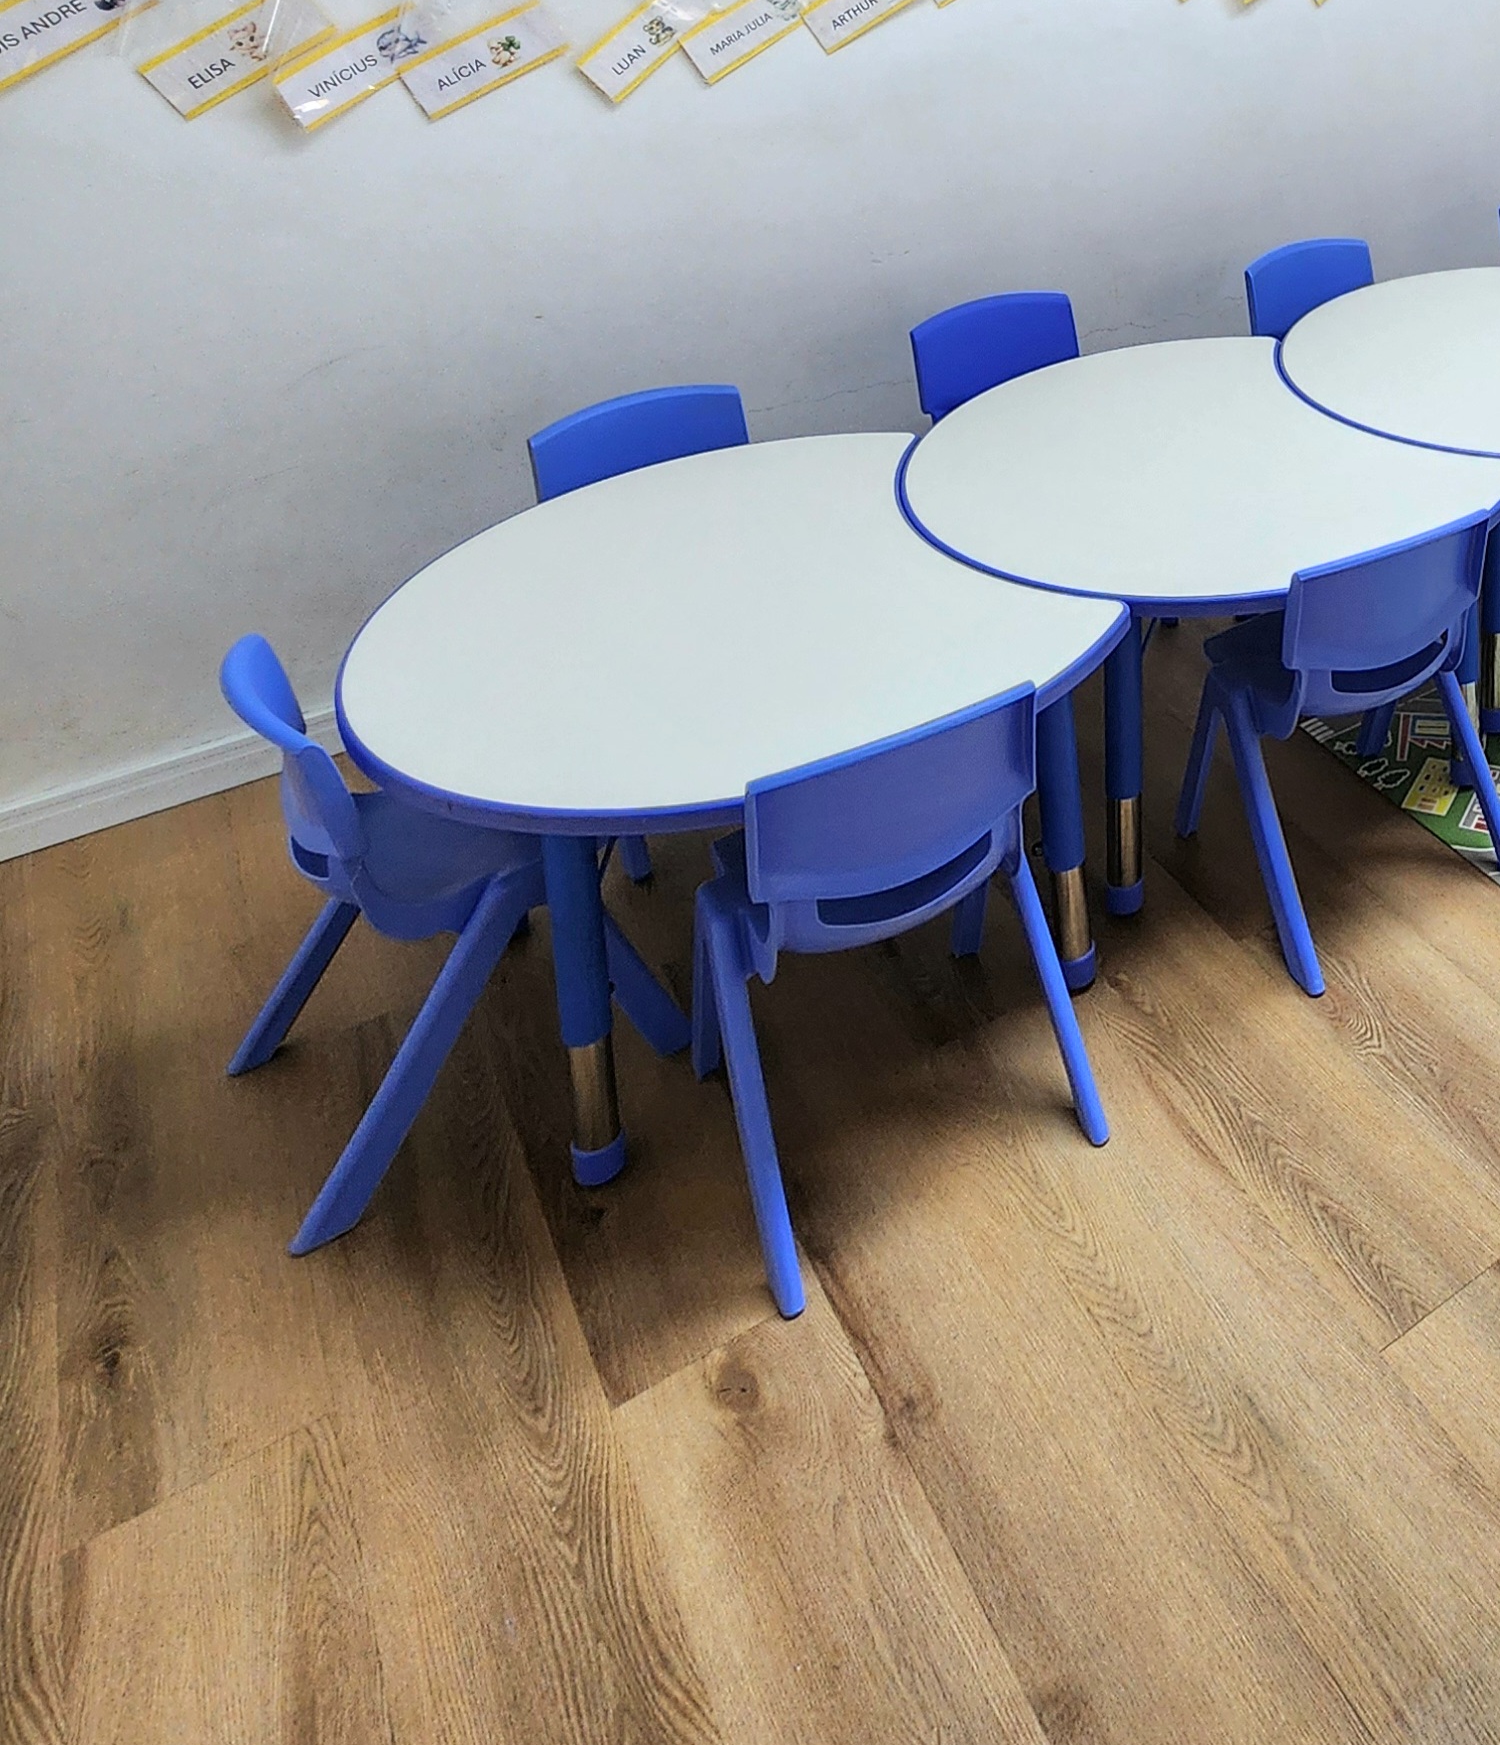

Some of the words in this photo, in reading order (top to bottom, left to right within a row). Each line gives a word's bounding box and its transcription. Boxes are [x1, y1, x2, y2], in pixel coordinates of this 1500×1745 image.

[0, 34, 20, 53] IS
[709, 29, 744, 55] MARIA
[188, 58, 236, 89] ELISA
[437, 58, 487, 91] ALÍCIA
[611, 44, 646, 76] LUAN
[307, 55, 378, 98] VINÍCIUS
